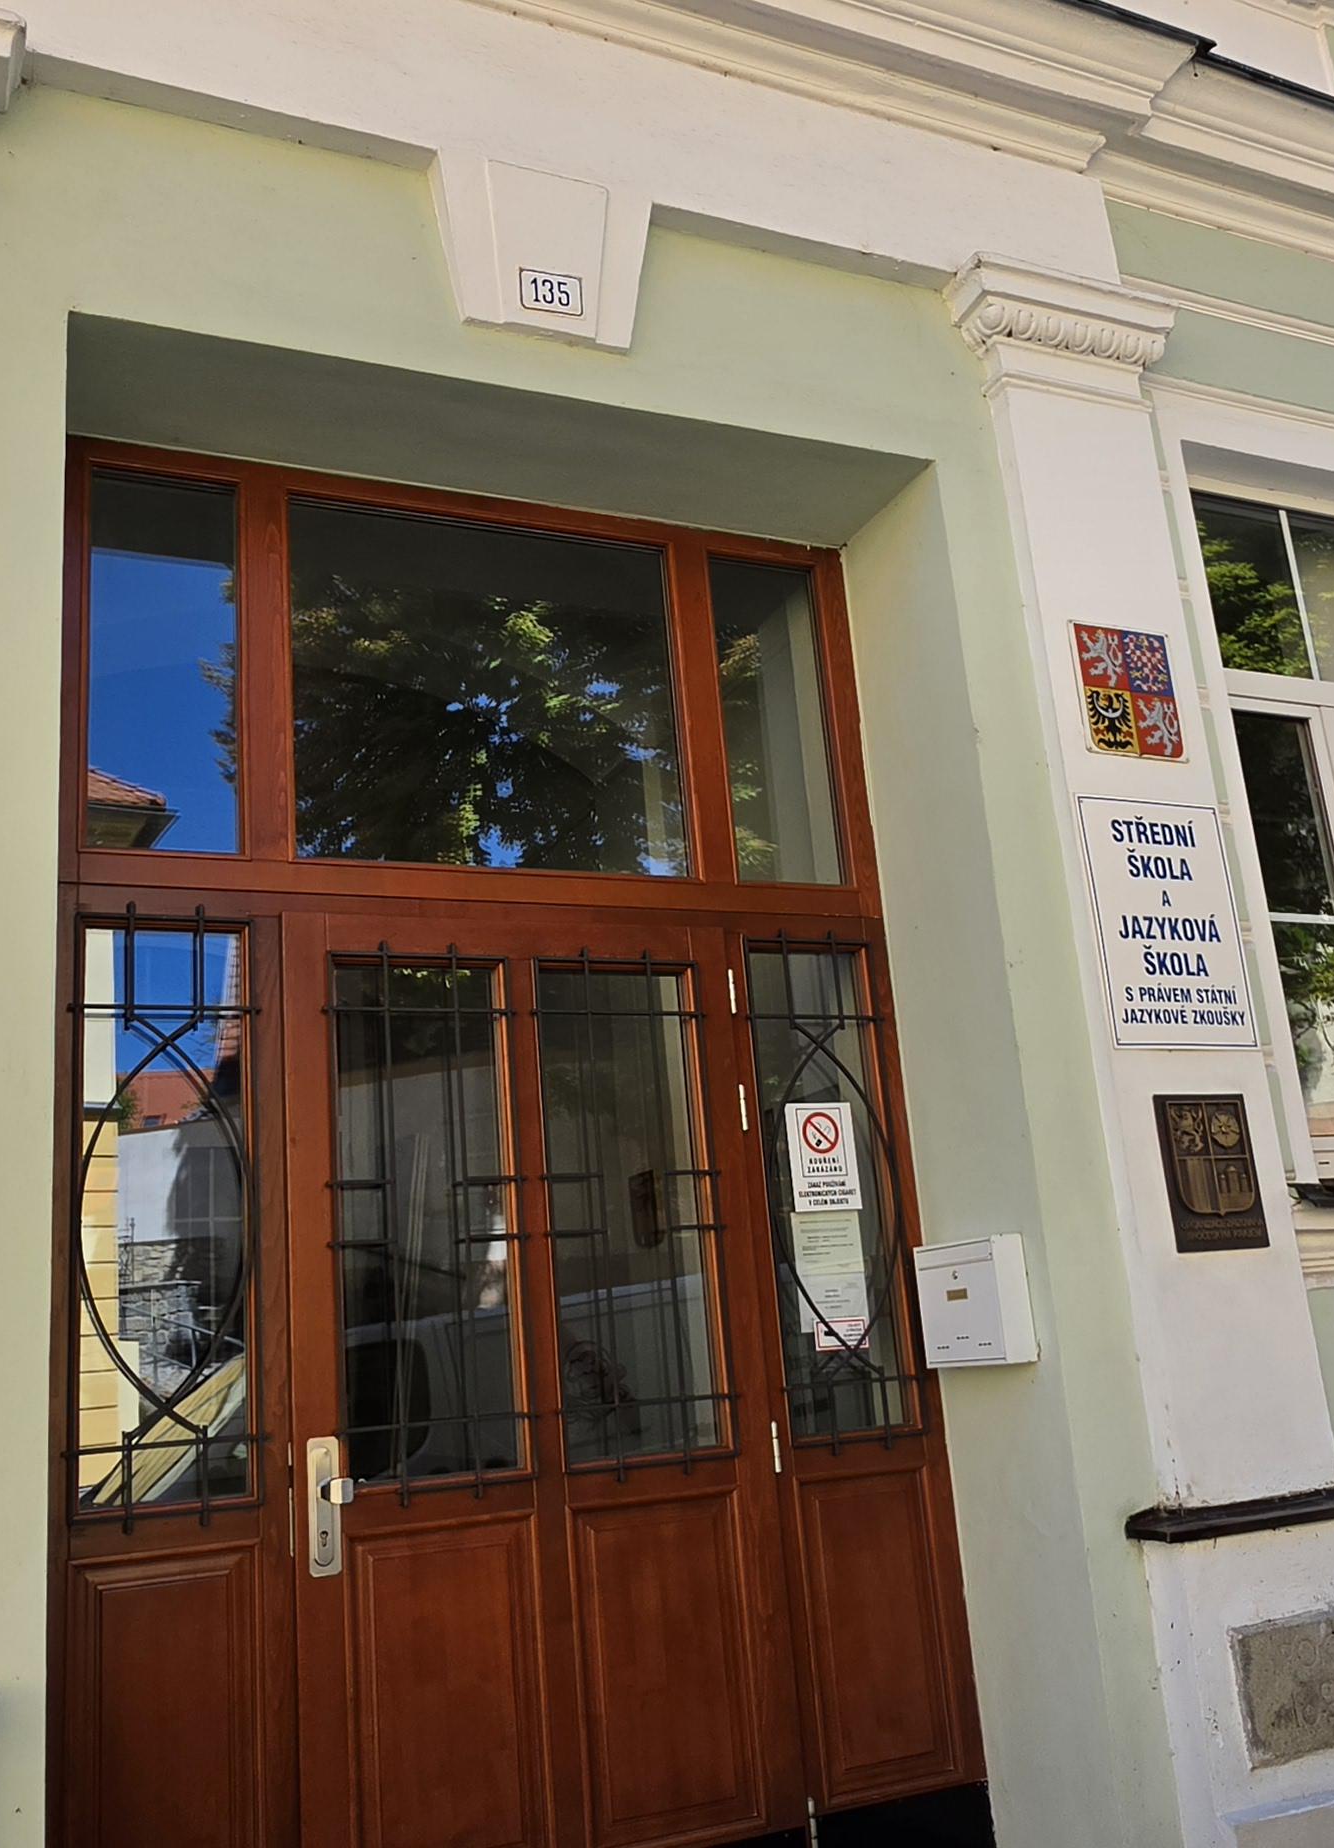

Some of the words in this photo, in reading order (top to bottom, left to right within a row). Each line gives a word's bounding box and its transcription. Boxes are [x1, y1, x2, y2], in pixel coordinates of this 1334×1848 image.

[530, 277, 570, 307] 135
[1111, 815, 1196, 848] STŘEDNÍ
[1127, 848, 1193, 881] ŠKOLA
[1162, 890, 1172, 907] A
[1119, 914, 1221, 943] JAZYKOVÁ
[1143, 944, 1209, 977] ŠKOLA
[1125, 986, 1134, 1002] S
[1138, 982, 1192, 1003] PRÁVEM
[1196, 984, 1237, 1005] STÁTNÍ
[1122, 1005, 1188, 1024] JAZYKOVÉ
[1191, 1006, 1245, 1026] ZKOUŠKY
[809, 1155, 839, 1165] KOUŘENÍ
